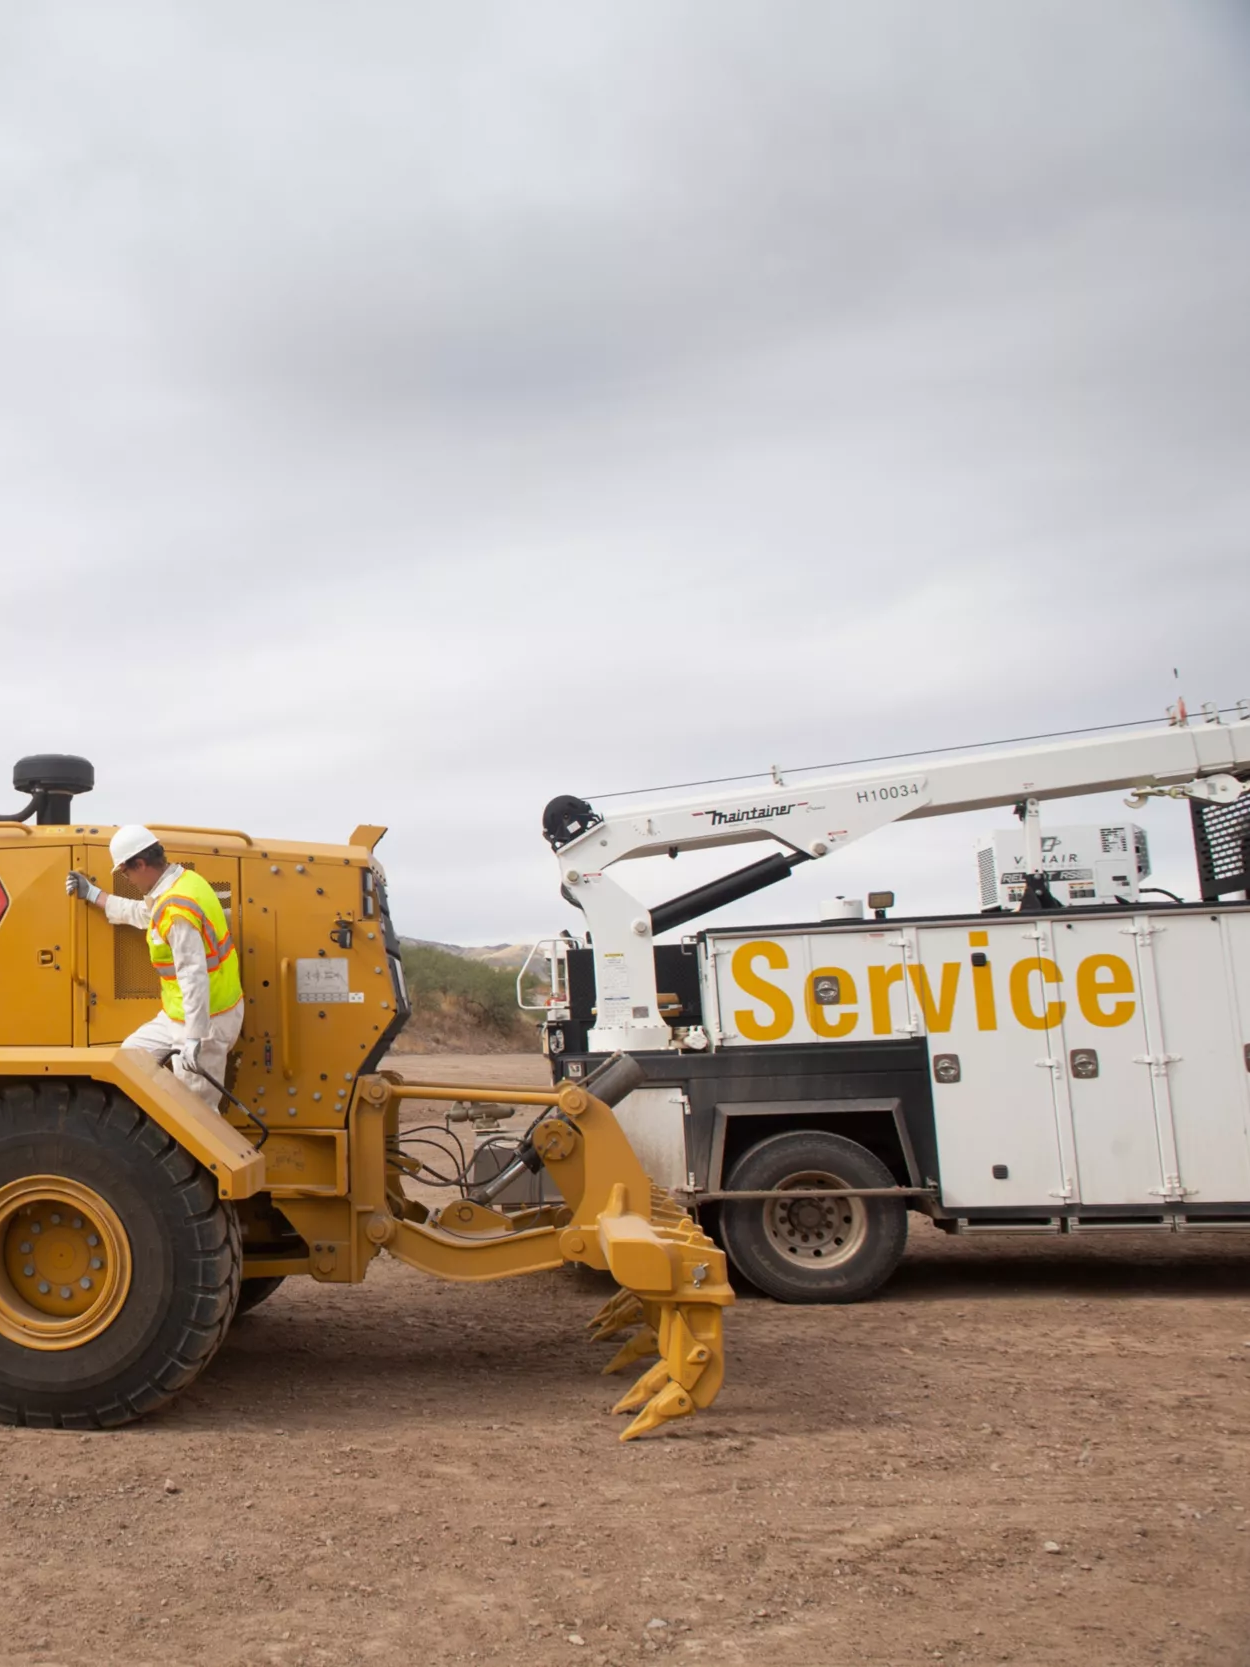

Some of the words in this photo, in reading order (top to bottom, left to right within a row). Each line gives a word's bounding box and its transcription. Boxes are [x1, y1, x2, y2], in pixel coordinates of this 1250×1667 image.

[856, 783, 919, 803] H10034
[705, 804, 796, 826] Maintainer
[1013, 853, 1078, 866] VNAIR
[731, 930, 1136, 1041] Service
